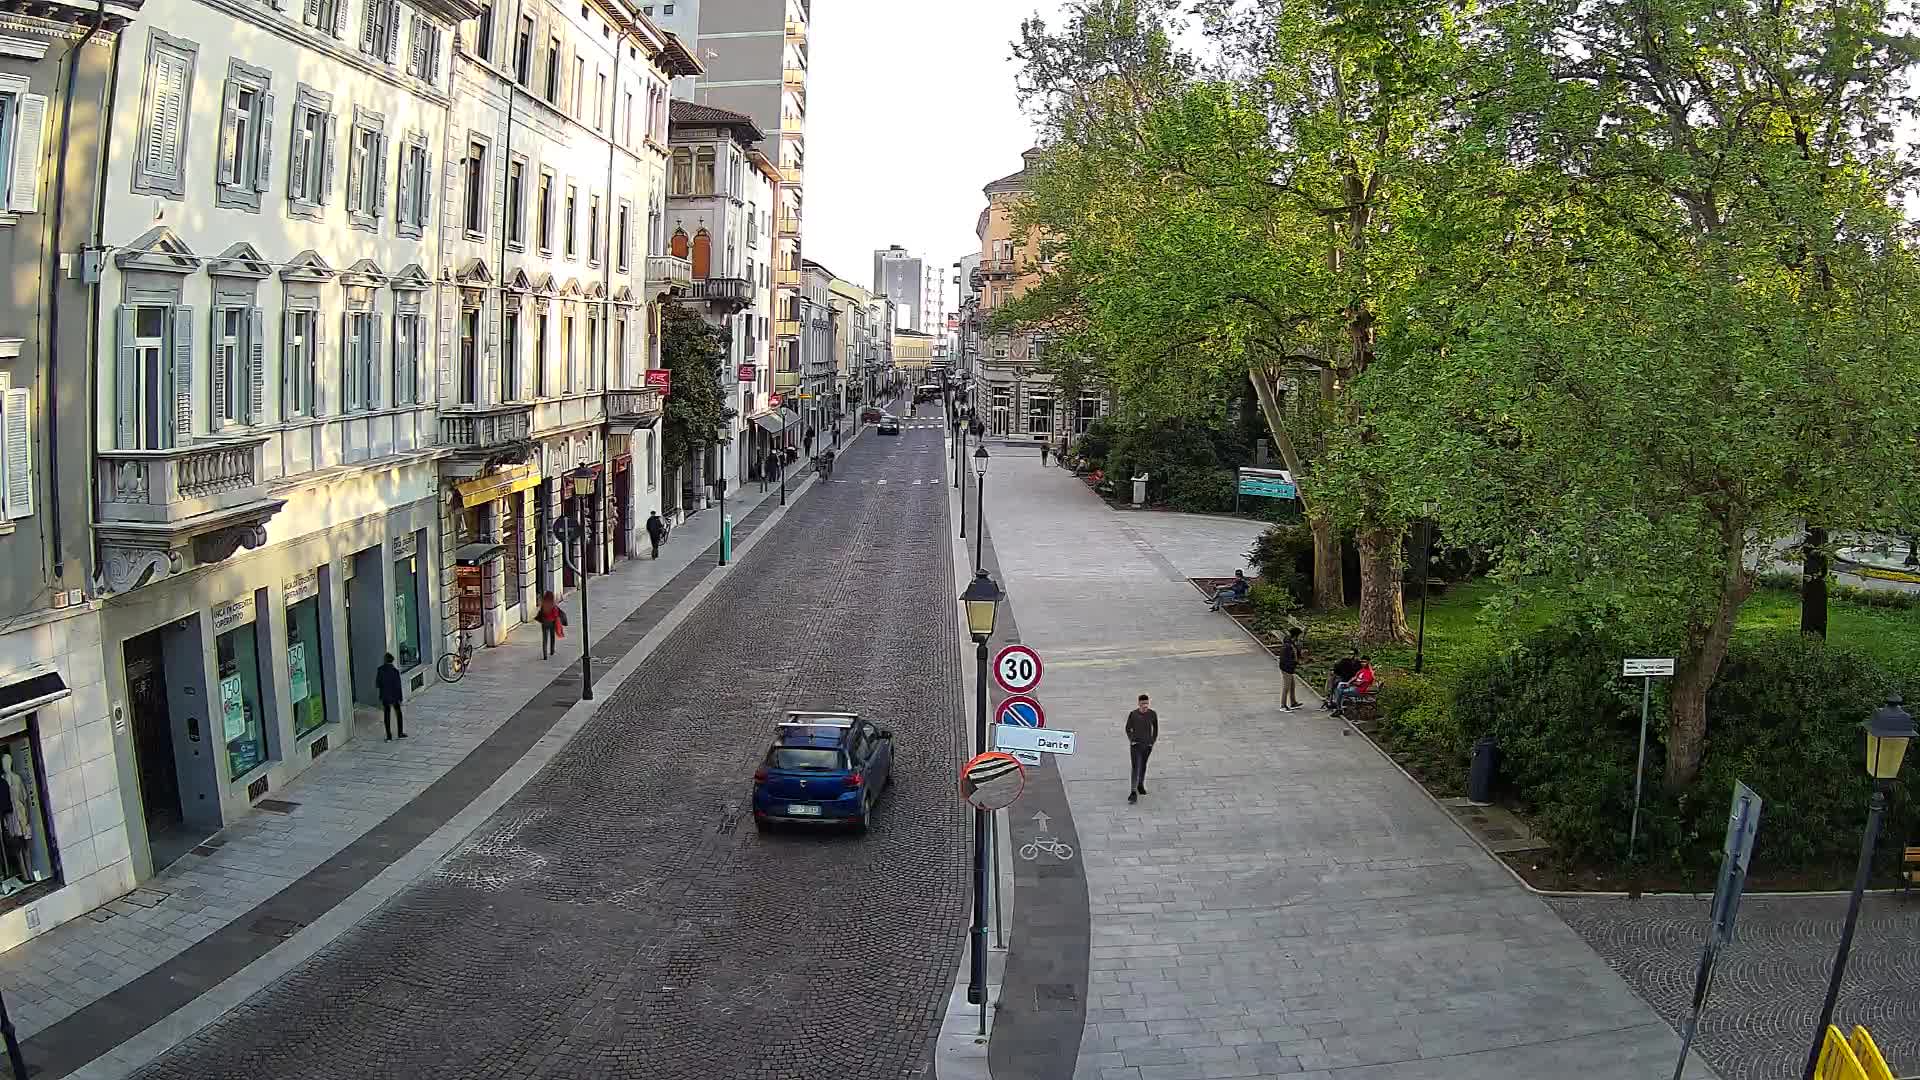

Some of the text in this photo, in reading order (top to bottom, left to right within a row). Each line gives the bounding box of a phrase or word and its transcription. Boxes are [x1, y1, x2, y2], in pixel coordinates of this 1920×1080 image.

[1005, 658, 1033, 680] 30
[222, 678, 241, 700] 130
[1038, 738, 1069, 749] Dante
